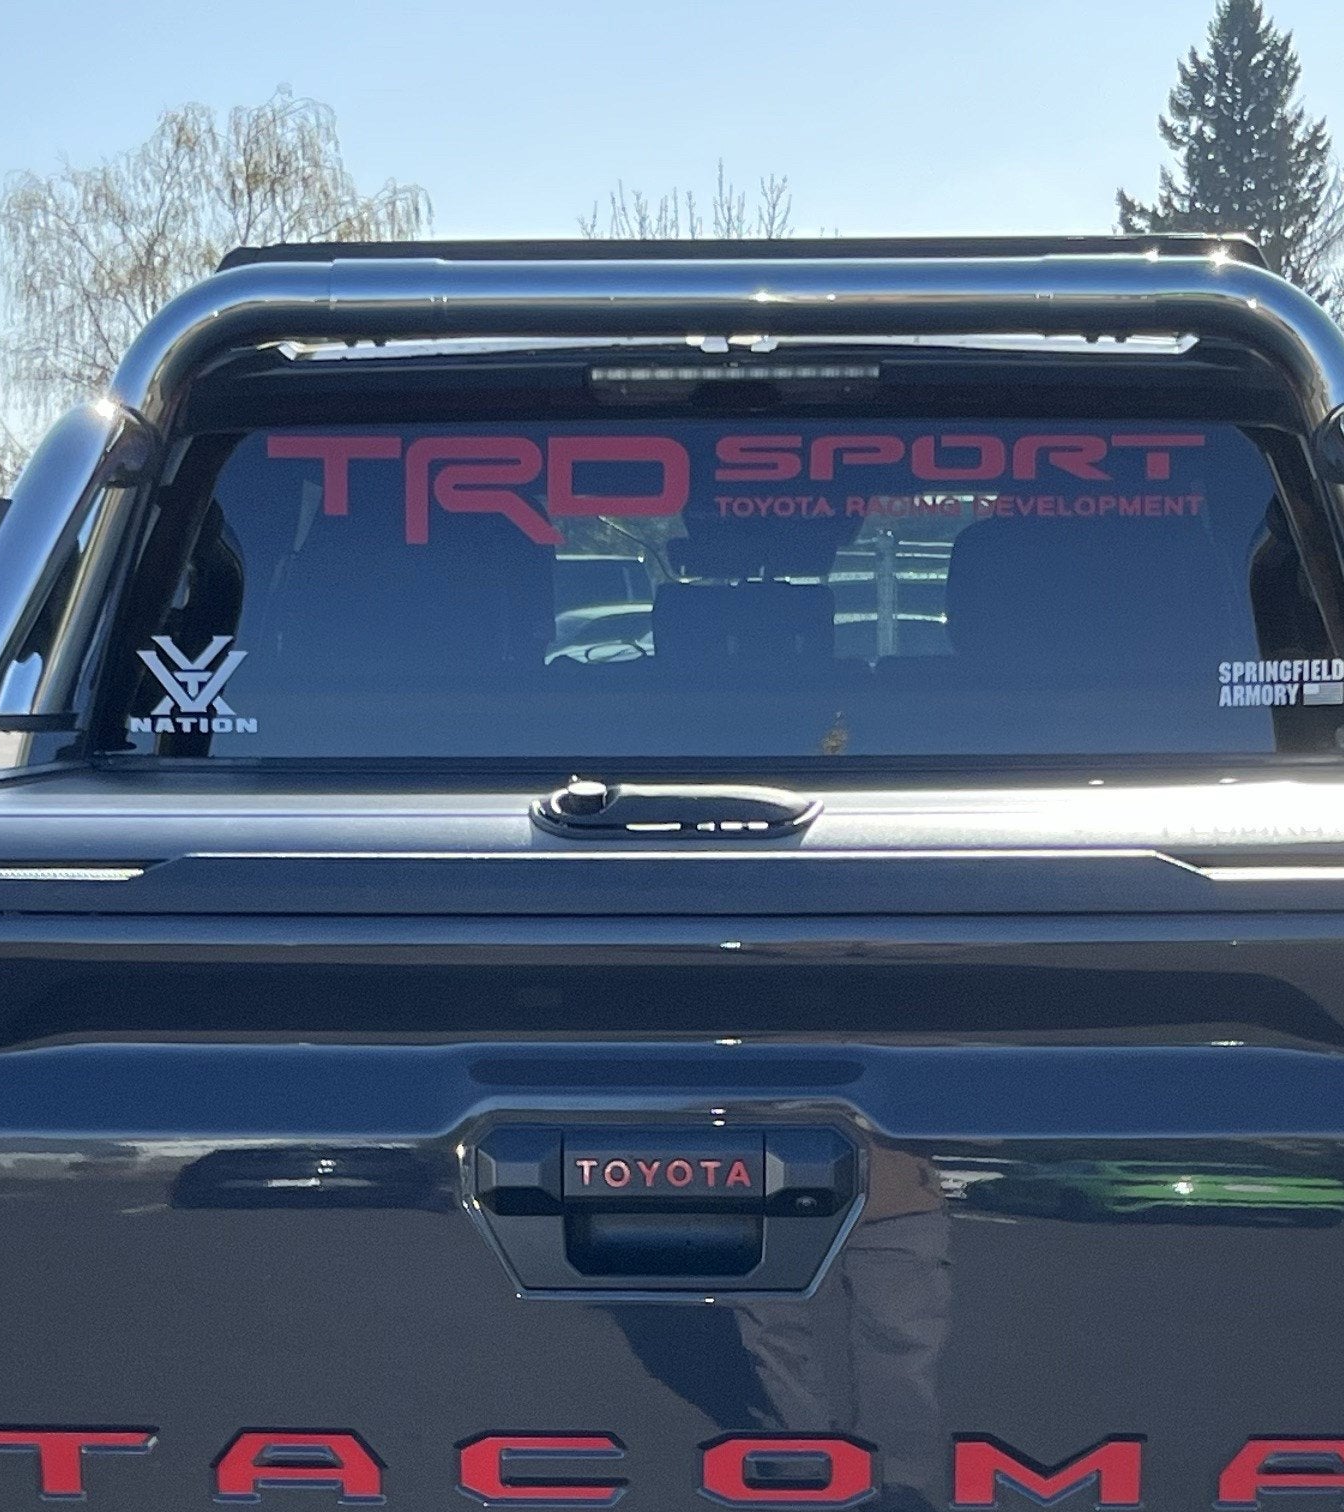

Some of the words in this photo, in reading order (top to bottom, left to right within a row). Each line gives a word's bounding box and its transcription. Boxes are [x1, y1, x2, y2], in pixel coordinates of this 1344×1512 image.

[714, 434, 1206, 482] SPORT
[267, 435, 690, 545] TRD
[715, 496, 835, 518] TOYOTA
[845, 496, 962, 518] RACING
[972, 495, 1204, 517] DEVELOPMENT
[1218, 683, 1300, 707] ARMORY
[129, 717, 258, 733] NATION
[575, 1158, 752, 1188] TOYOTA
